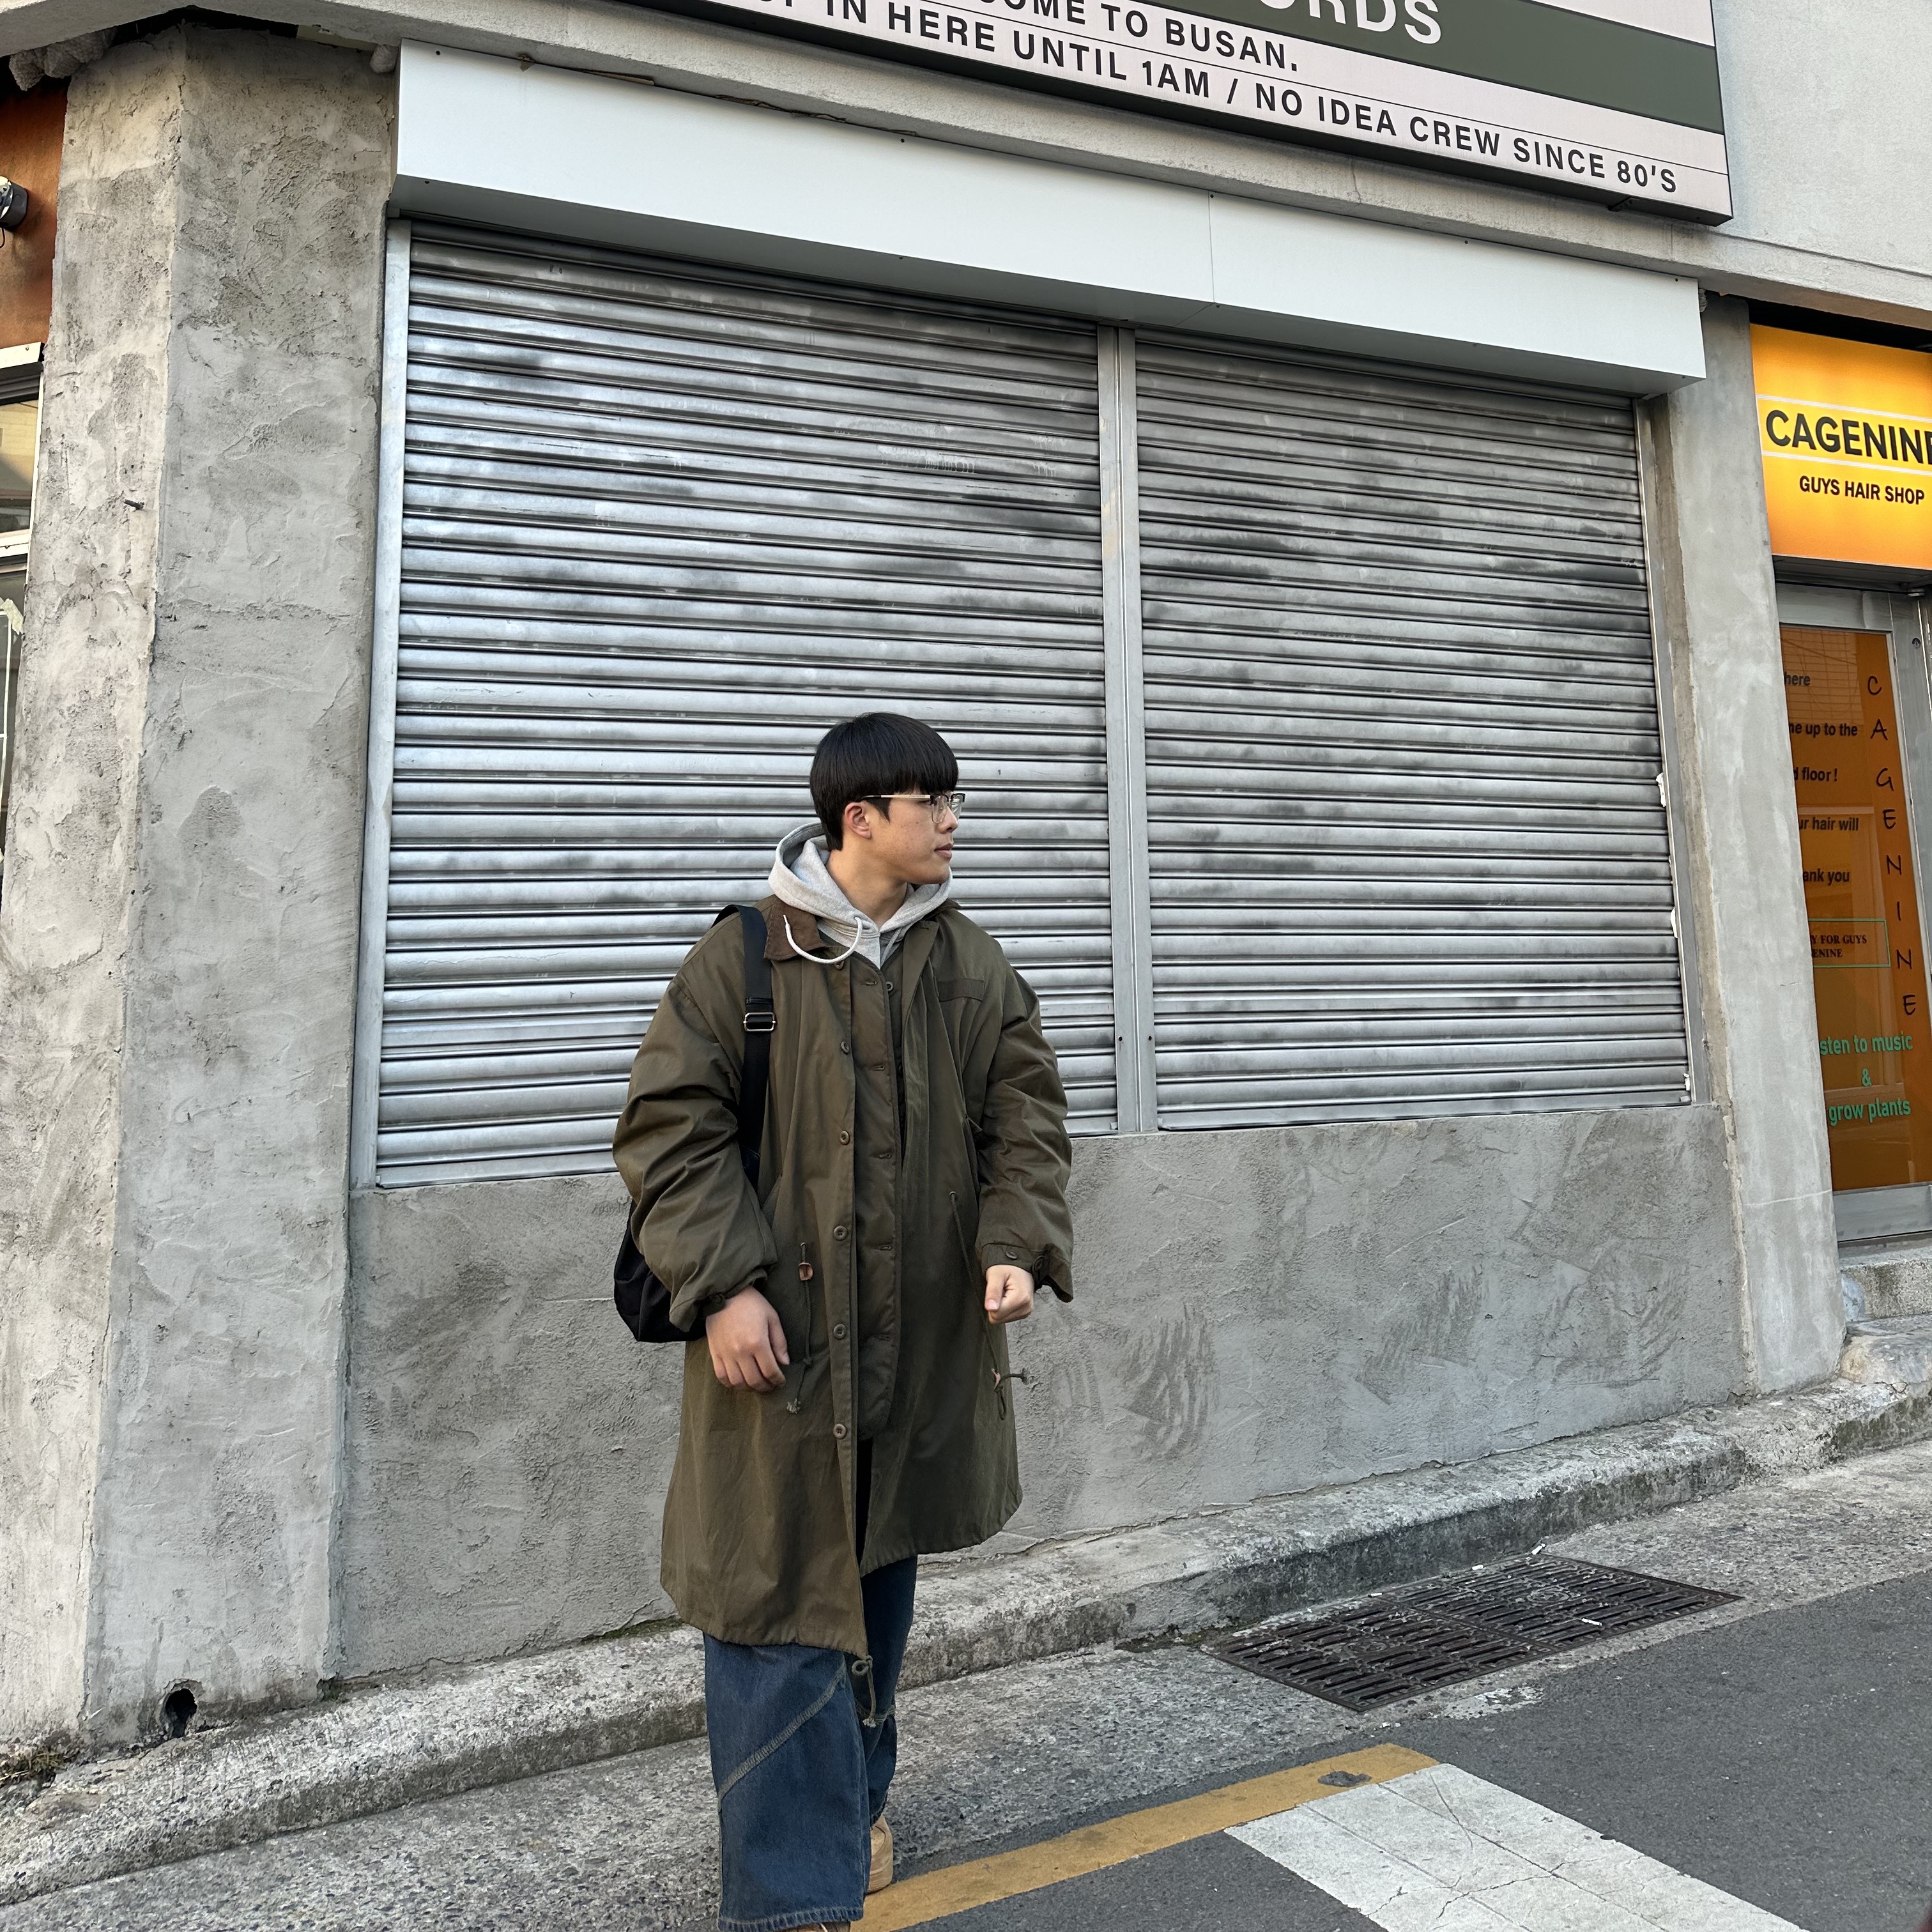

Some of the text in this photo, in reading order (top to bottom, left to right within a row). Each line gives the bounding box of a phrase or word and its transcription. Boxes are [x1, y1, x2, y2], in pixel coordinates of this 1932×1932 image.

[1101, 3, 1147, 37] TO
[1166, 19, 1297, 68] BUSAN.
[827, 0, 1676, 193] IN HERE UNTIL 1AM / NO IDEA CREW SINCE 80'S
[1799, 475, 1925, 505] GUYS HAIR SHOP
[1806, 723, 1820, 738] up
[1825, 723, 1836, 736] to
[1839, 723, 1858, 736] the
[1813, 816, 1836, 830] hair
[1839, 817, 1859, 831] will
[1828, 871, 1850, 886] you
[1820, 935, 1840, 944] FOR
[1843, 934, 1867, 944] GUYS
[1853, 1034, 1868, 1053] to
[1871, 1031, 1913, 1052] music
[1861, 1068, 1871, 1087] &
[1828, 1097, 1911, 1127] grow plants
